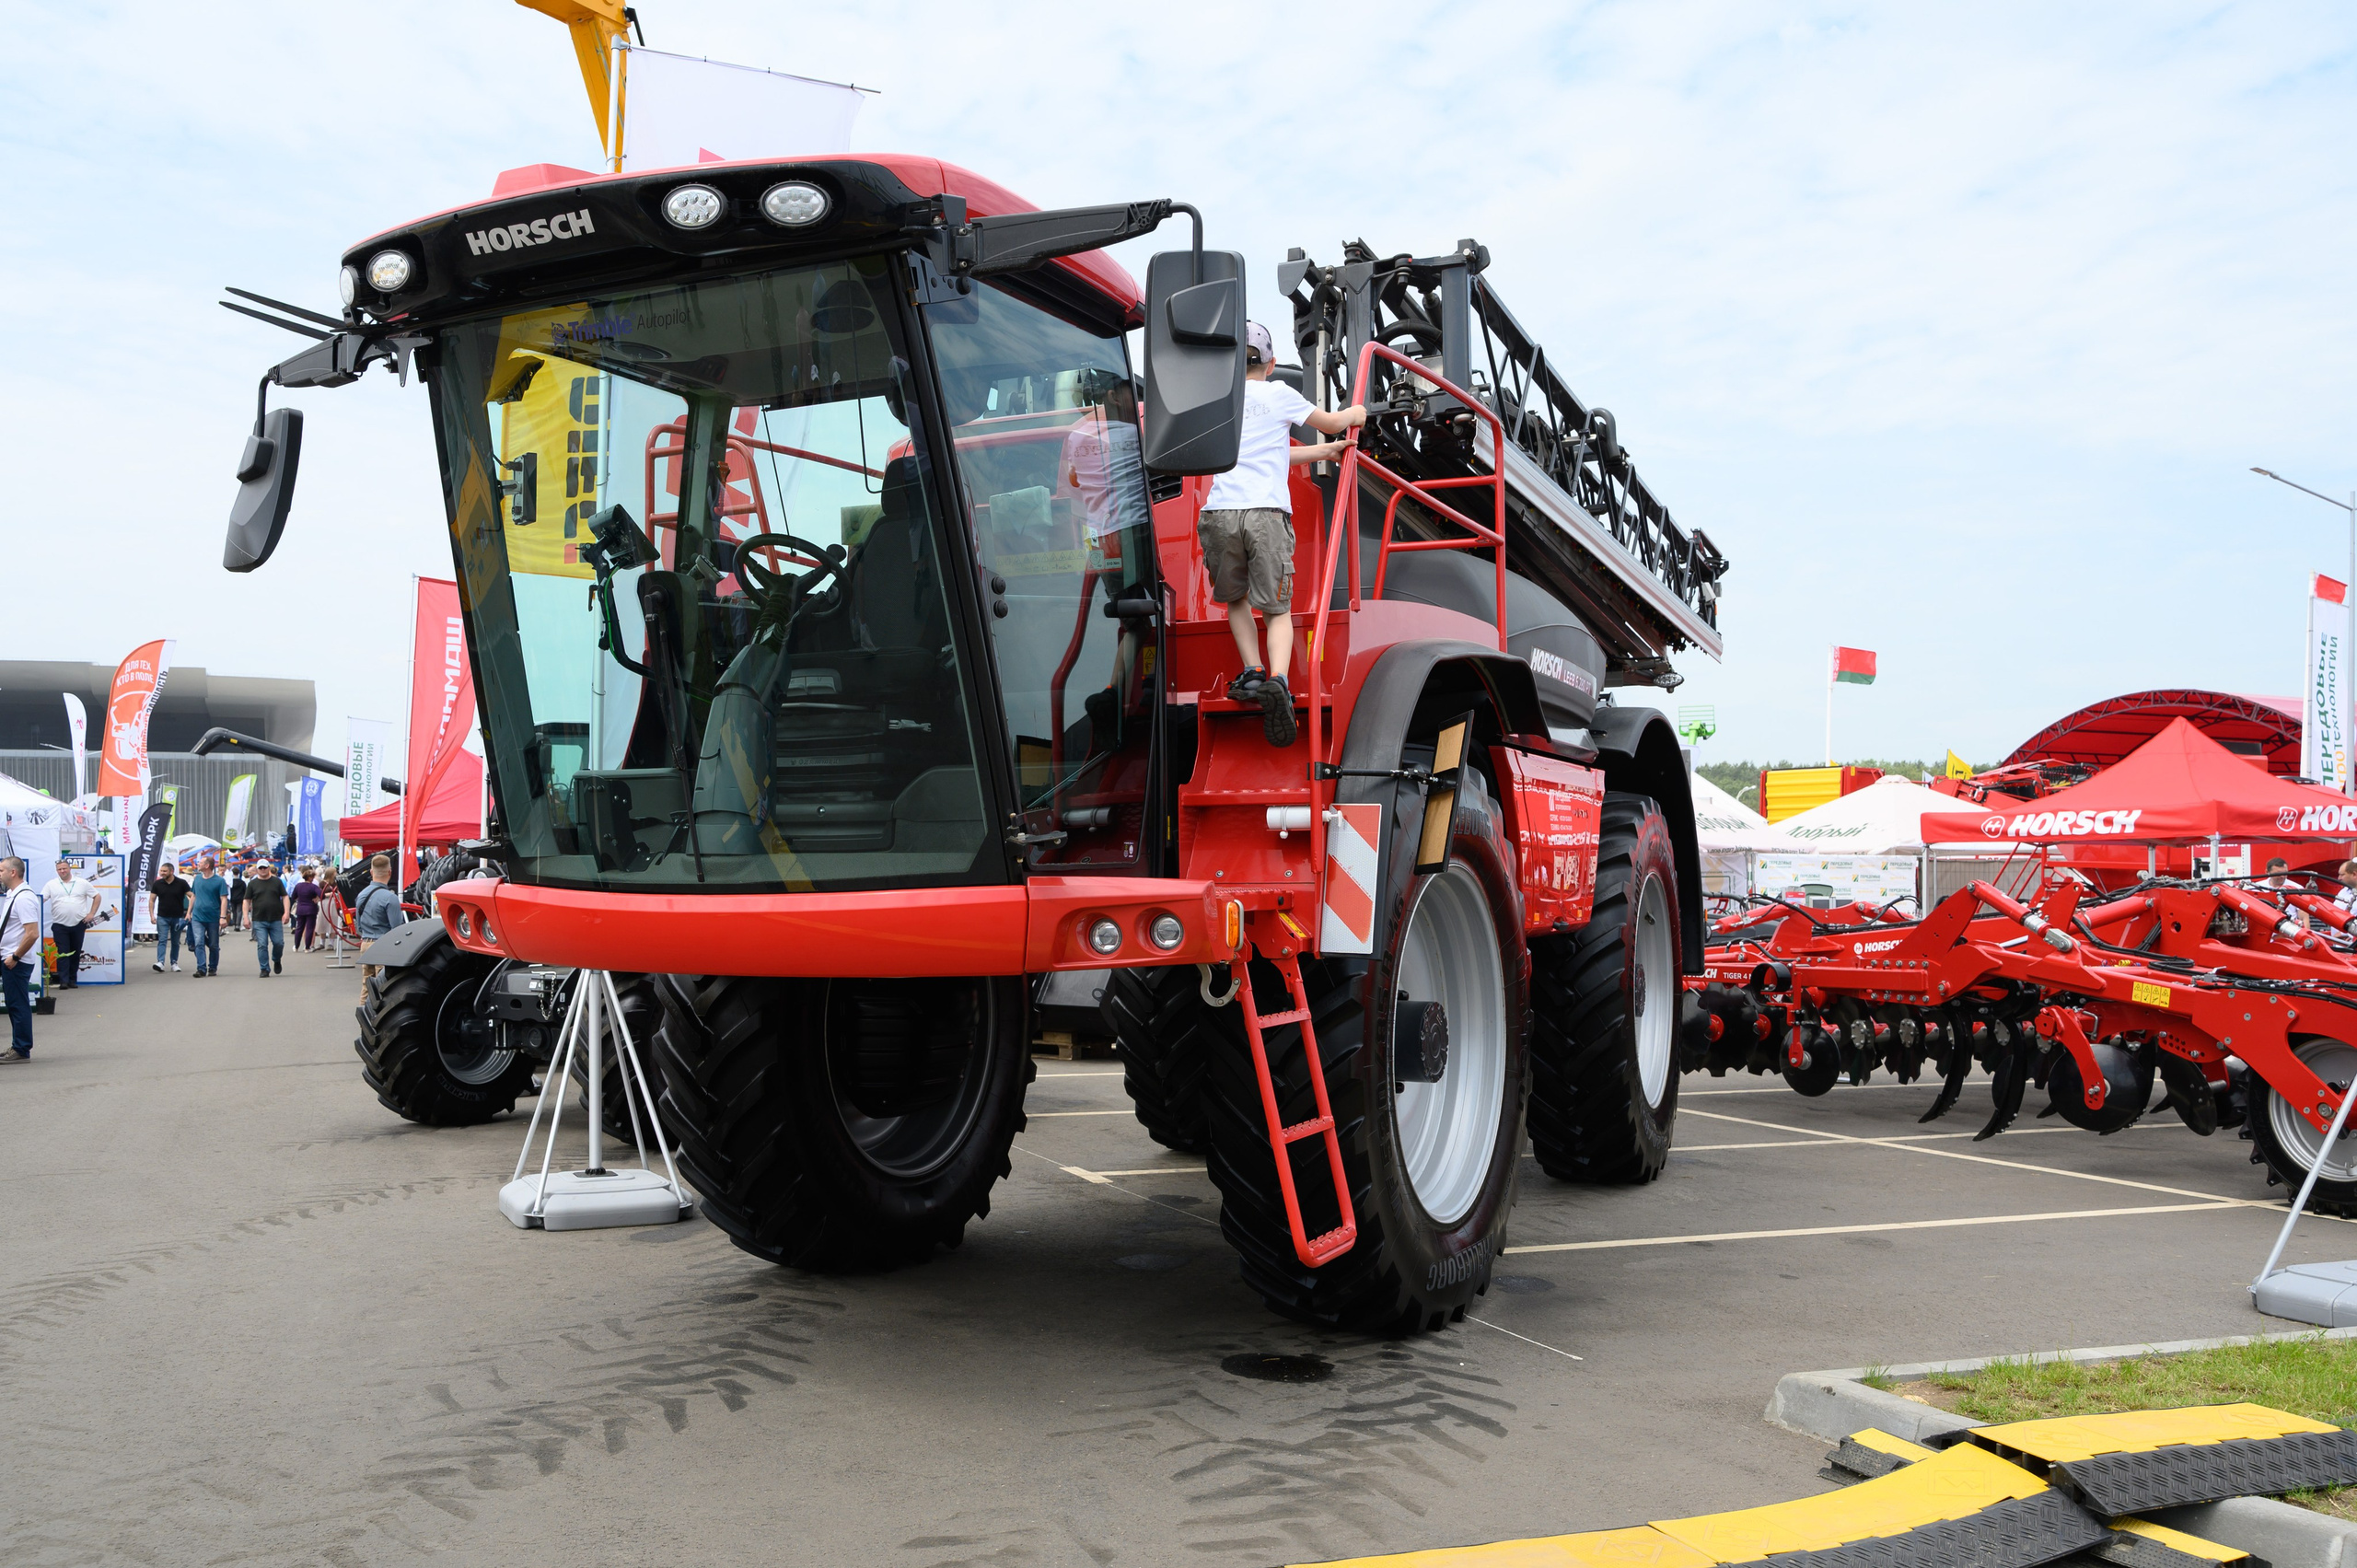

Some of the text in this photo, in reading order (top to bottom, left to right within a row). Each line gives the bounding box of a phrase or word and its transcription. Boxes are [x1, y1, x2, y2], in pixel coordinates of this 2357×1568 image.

[465, 209, 596, 256] HORSCH
[637, 308, 691, 331] Autopilot
[124, 659, 152, 674] ДЛЯ ТЕХ
[1530, 647, 1563, 679] HORSCH
[116, 671, 155, 688] КТО В ПОЛЕ
[351, 741, 365, 816] ЕРЕДОВЫЕ
[144, 816, 160, 852] ПАРК
[2007, 809, 2142, 837] HORSCH
[66, 858, 84, 868] CAT
[1723, 971, 1743, 981] TIGER
[1743, 972, 1748, 981] 4
[1426, 1233, 1494, 1292] TRELLEBORG
